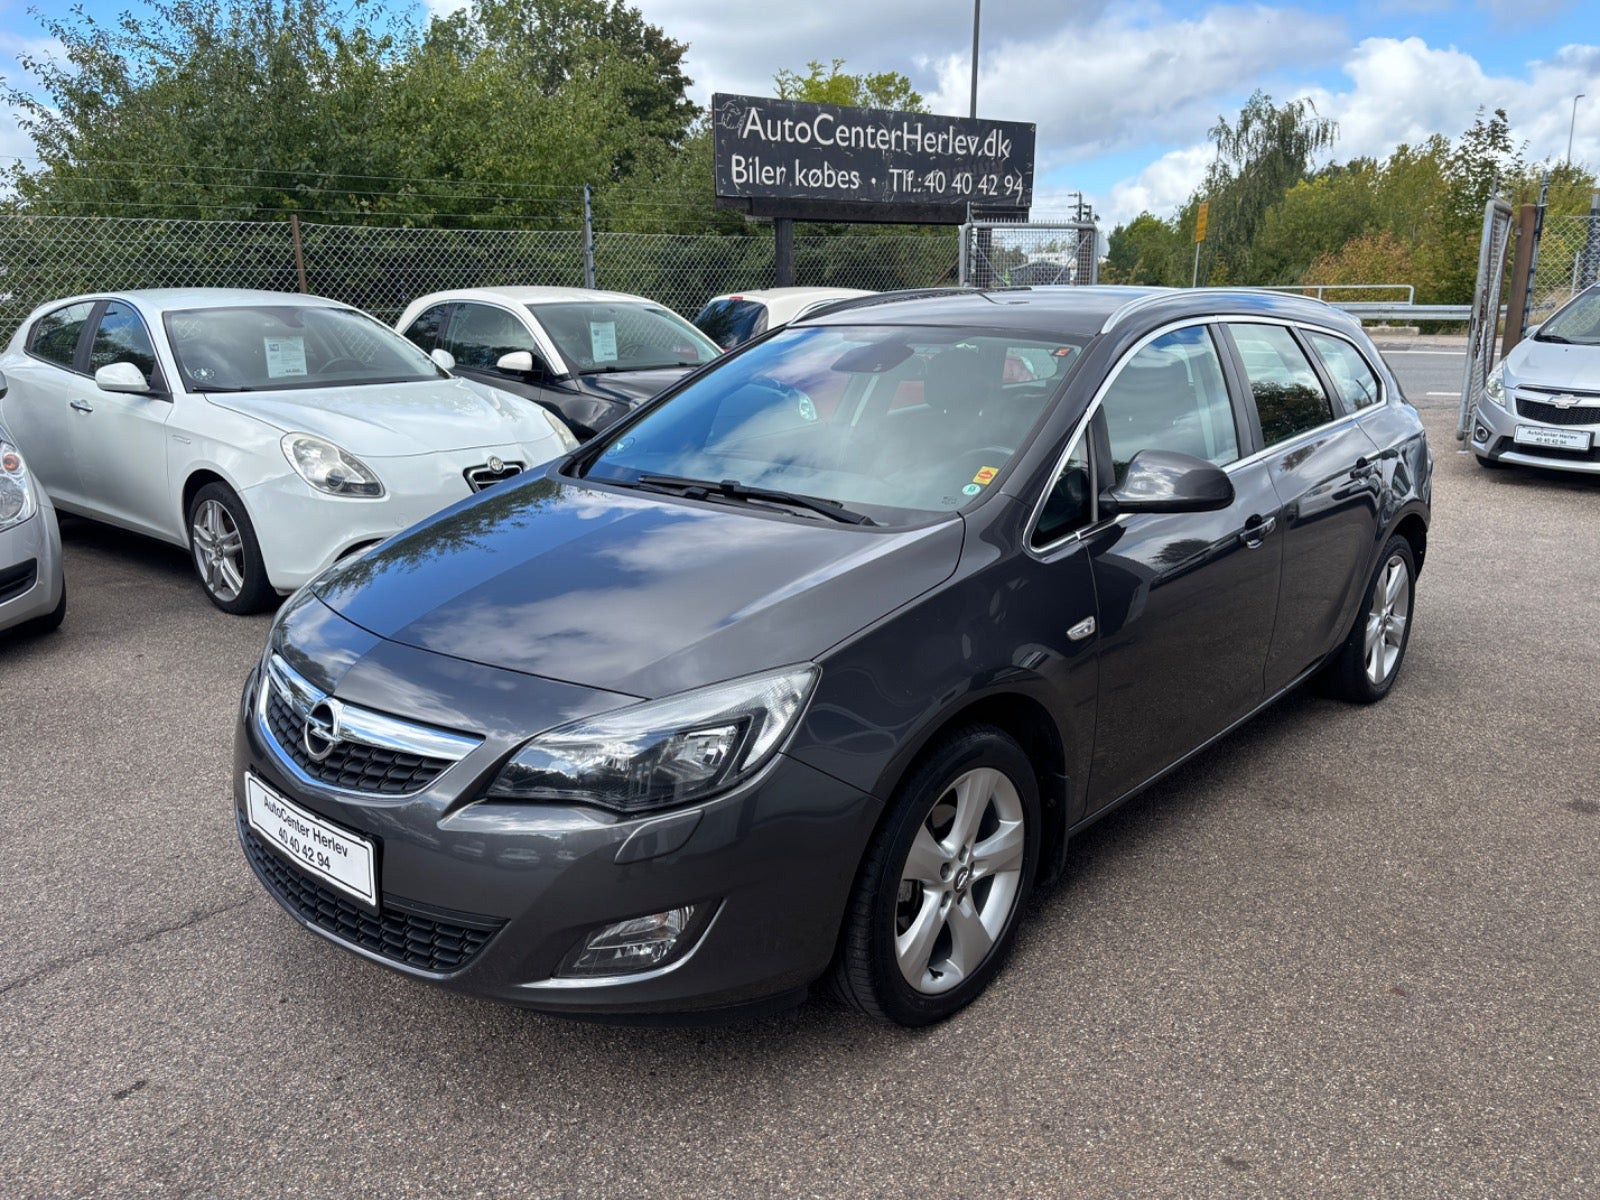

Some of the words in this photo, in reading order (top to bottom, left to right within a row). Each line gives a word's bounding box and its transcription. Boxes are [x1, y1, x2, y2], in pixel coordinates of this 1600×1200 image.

[743, 107, 1011, 158] AutoCenterHerlev.dk
[731, 154, 786, 185] Biler
[795, 158, 861, 189] købes
[952, 172, 972, 195] 40
[978, 174, 998, 196] 42
[1004, 175, 1024, 202] 94
[264, 795, 310, 838] AutoCenter
[313, 827, 349, 857] Herlev
[278, 827, 288, 844] 40
[290, 836, 300, 853] 40
[302, 845, 315, 862] 42
[317, 852, 331, 870] 94
